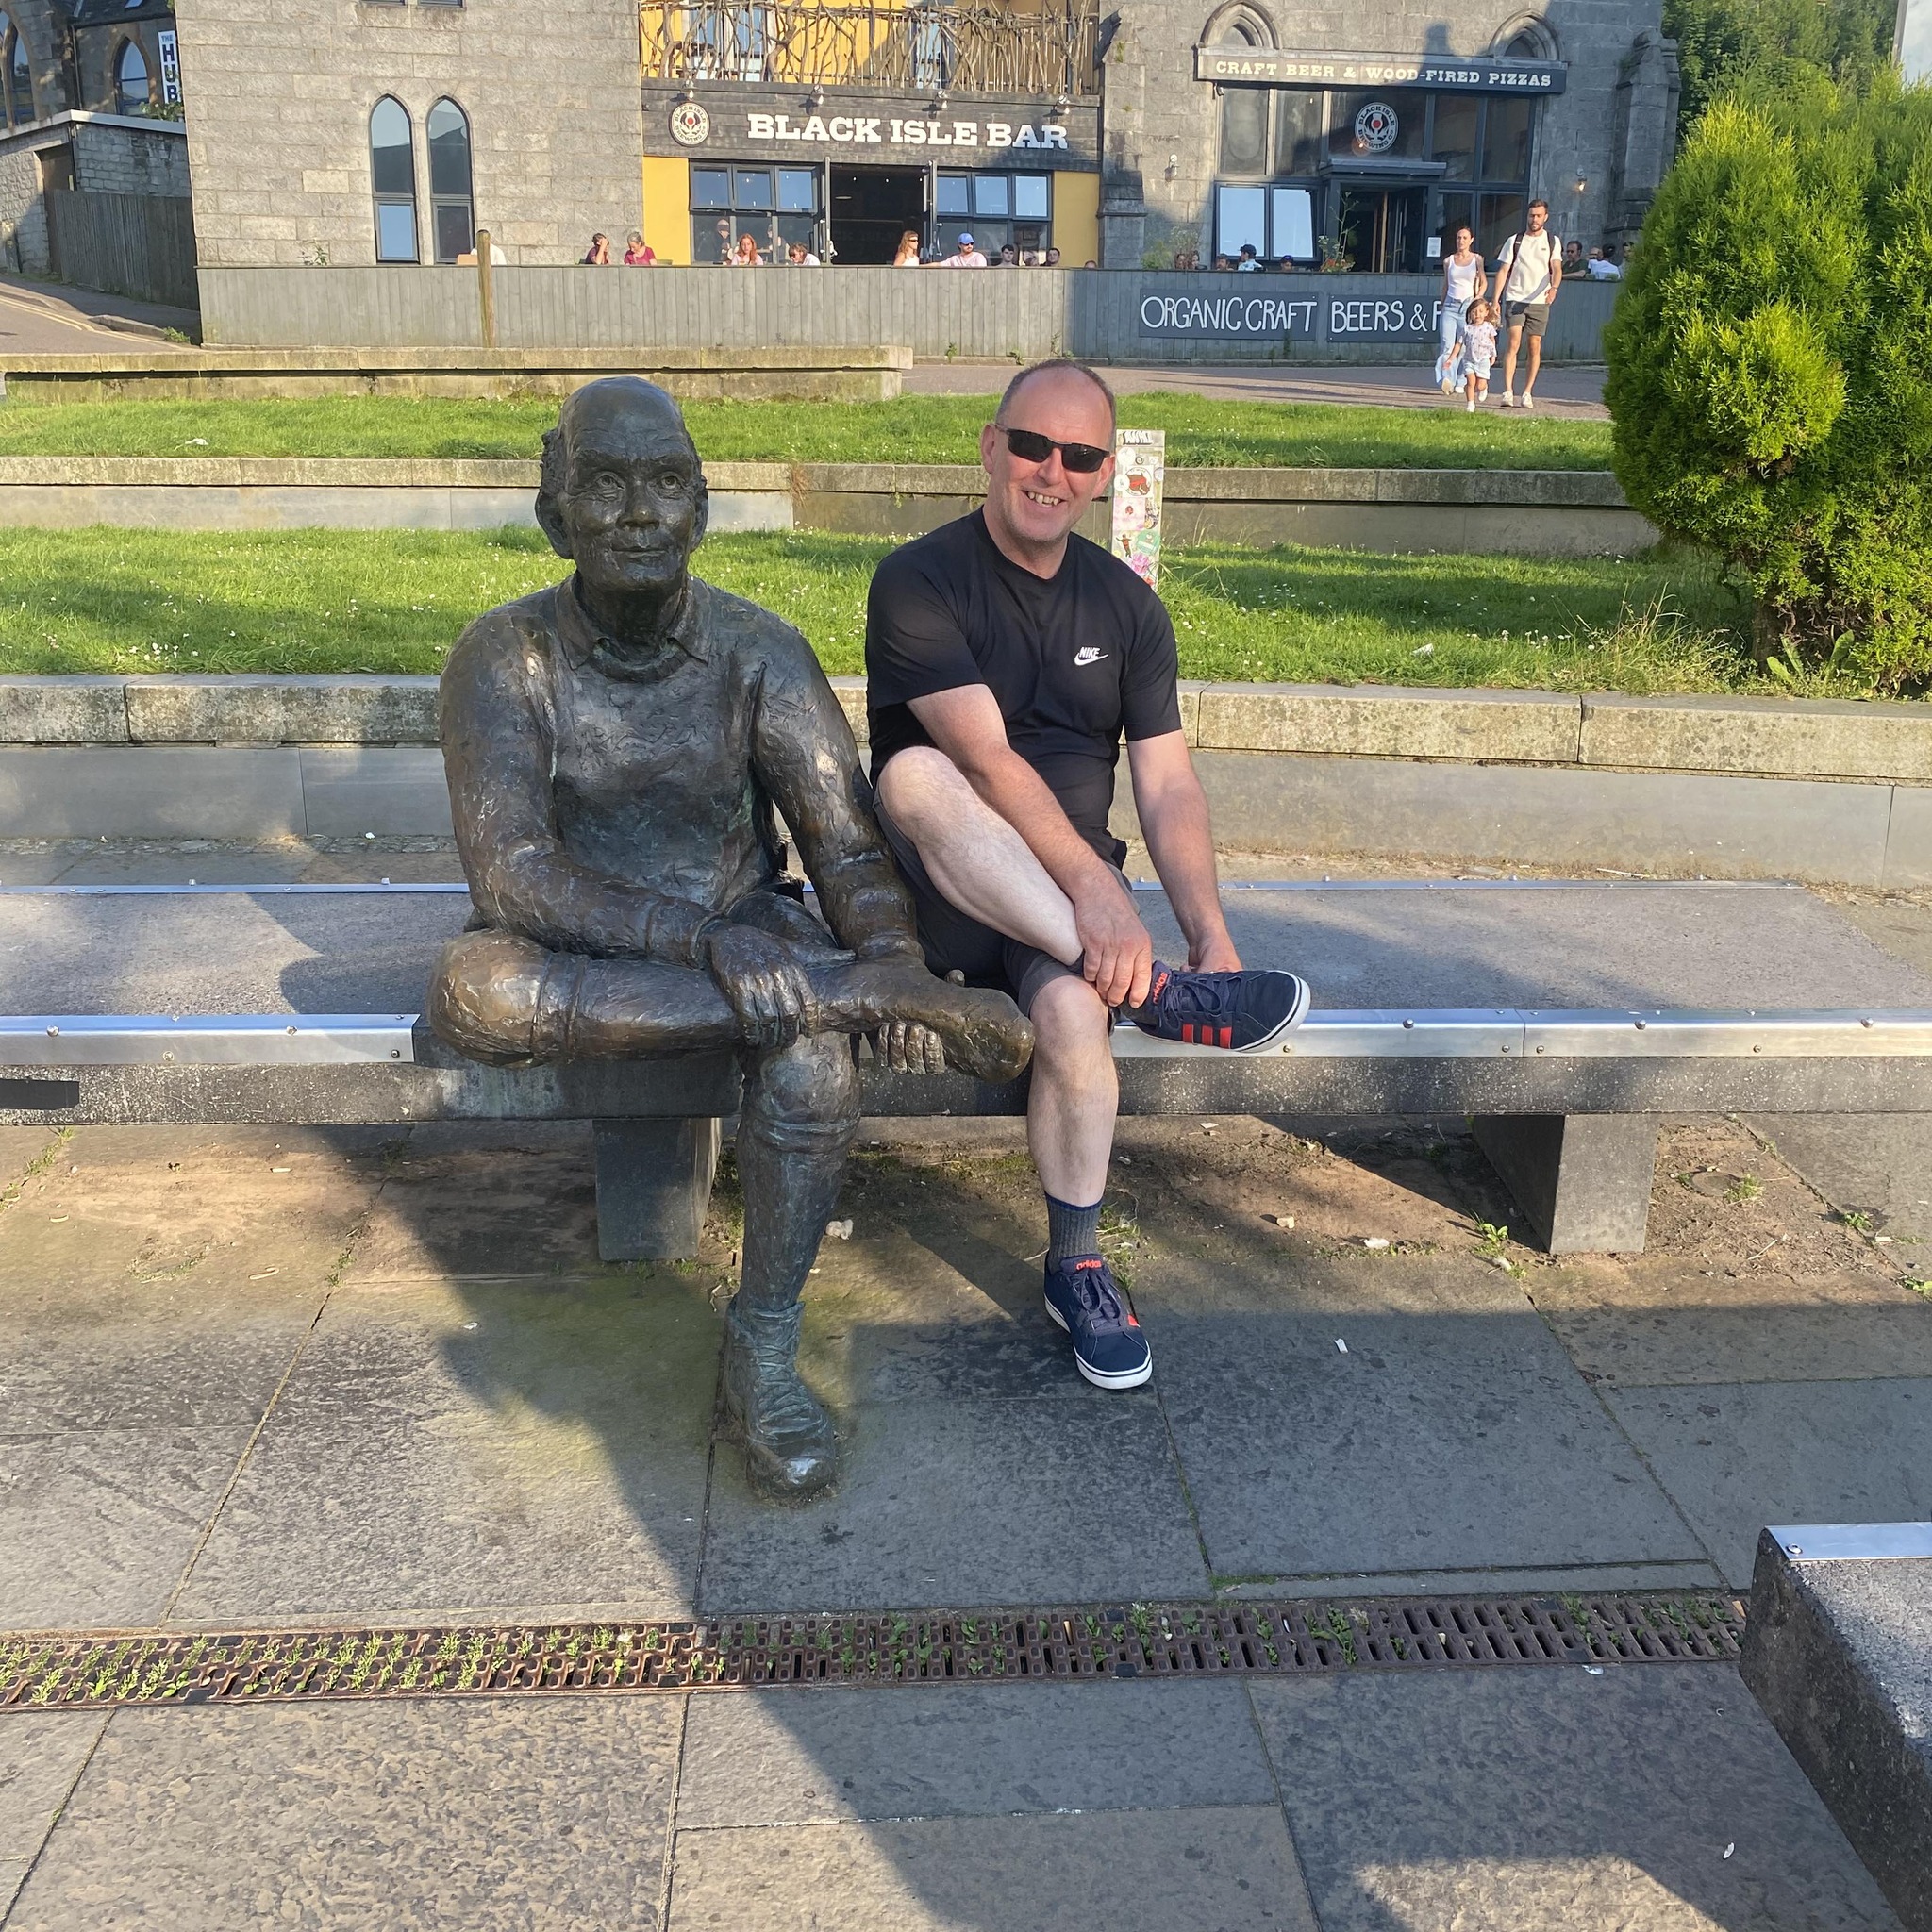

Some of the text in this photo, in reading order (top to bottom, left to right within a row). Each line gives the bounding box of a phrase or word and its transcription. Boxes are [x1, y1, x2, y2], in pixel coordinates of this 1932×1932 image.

[161, 34, 173, 42] THE
[162, 43, 178, 103] HUB
[1216, 60, 1552, 87] CRAFT BEER & WOOD-FIRED PIZZAS
[1358, 105, 1395, 126] BLACK ISLE
[747, 113, 1069, 150] BLACK ISLE BAR
[1141, 296, 1243, 330] ORGANIC
[1244, 298, 1317, 332] CRAFT
[1331, 300, 1405, 333] BEERS
[1409, 303, 1427, 332] &
[1078, 646, 1101, 658] NIKE
